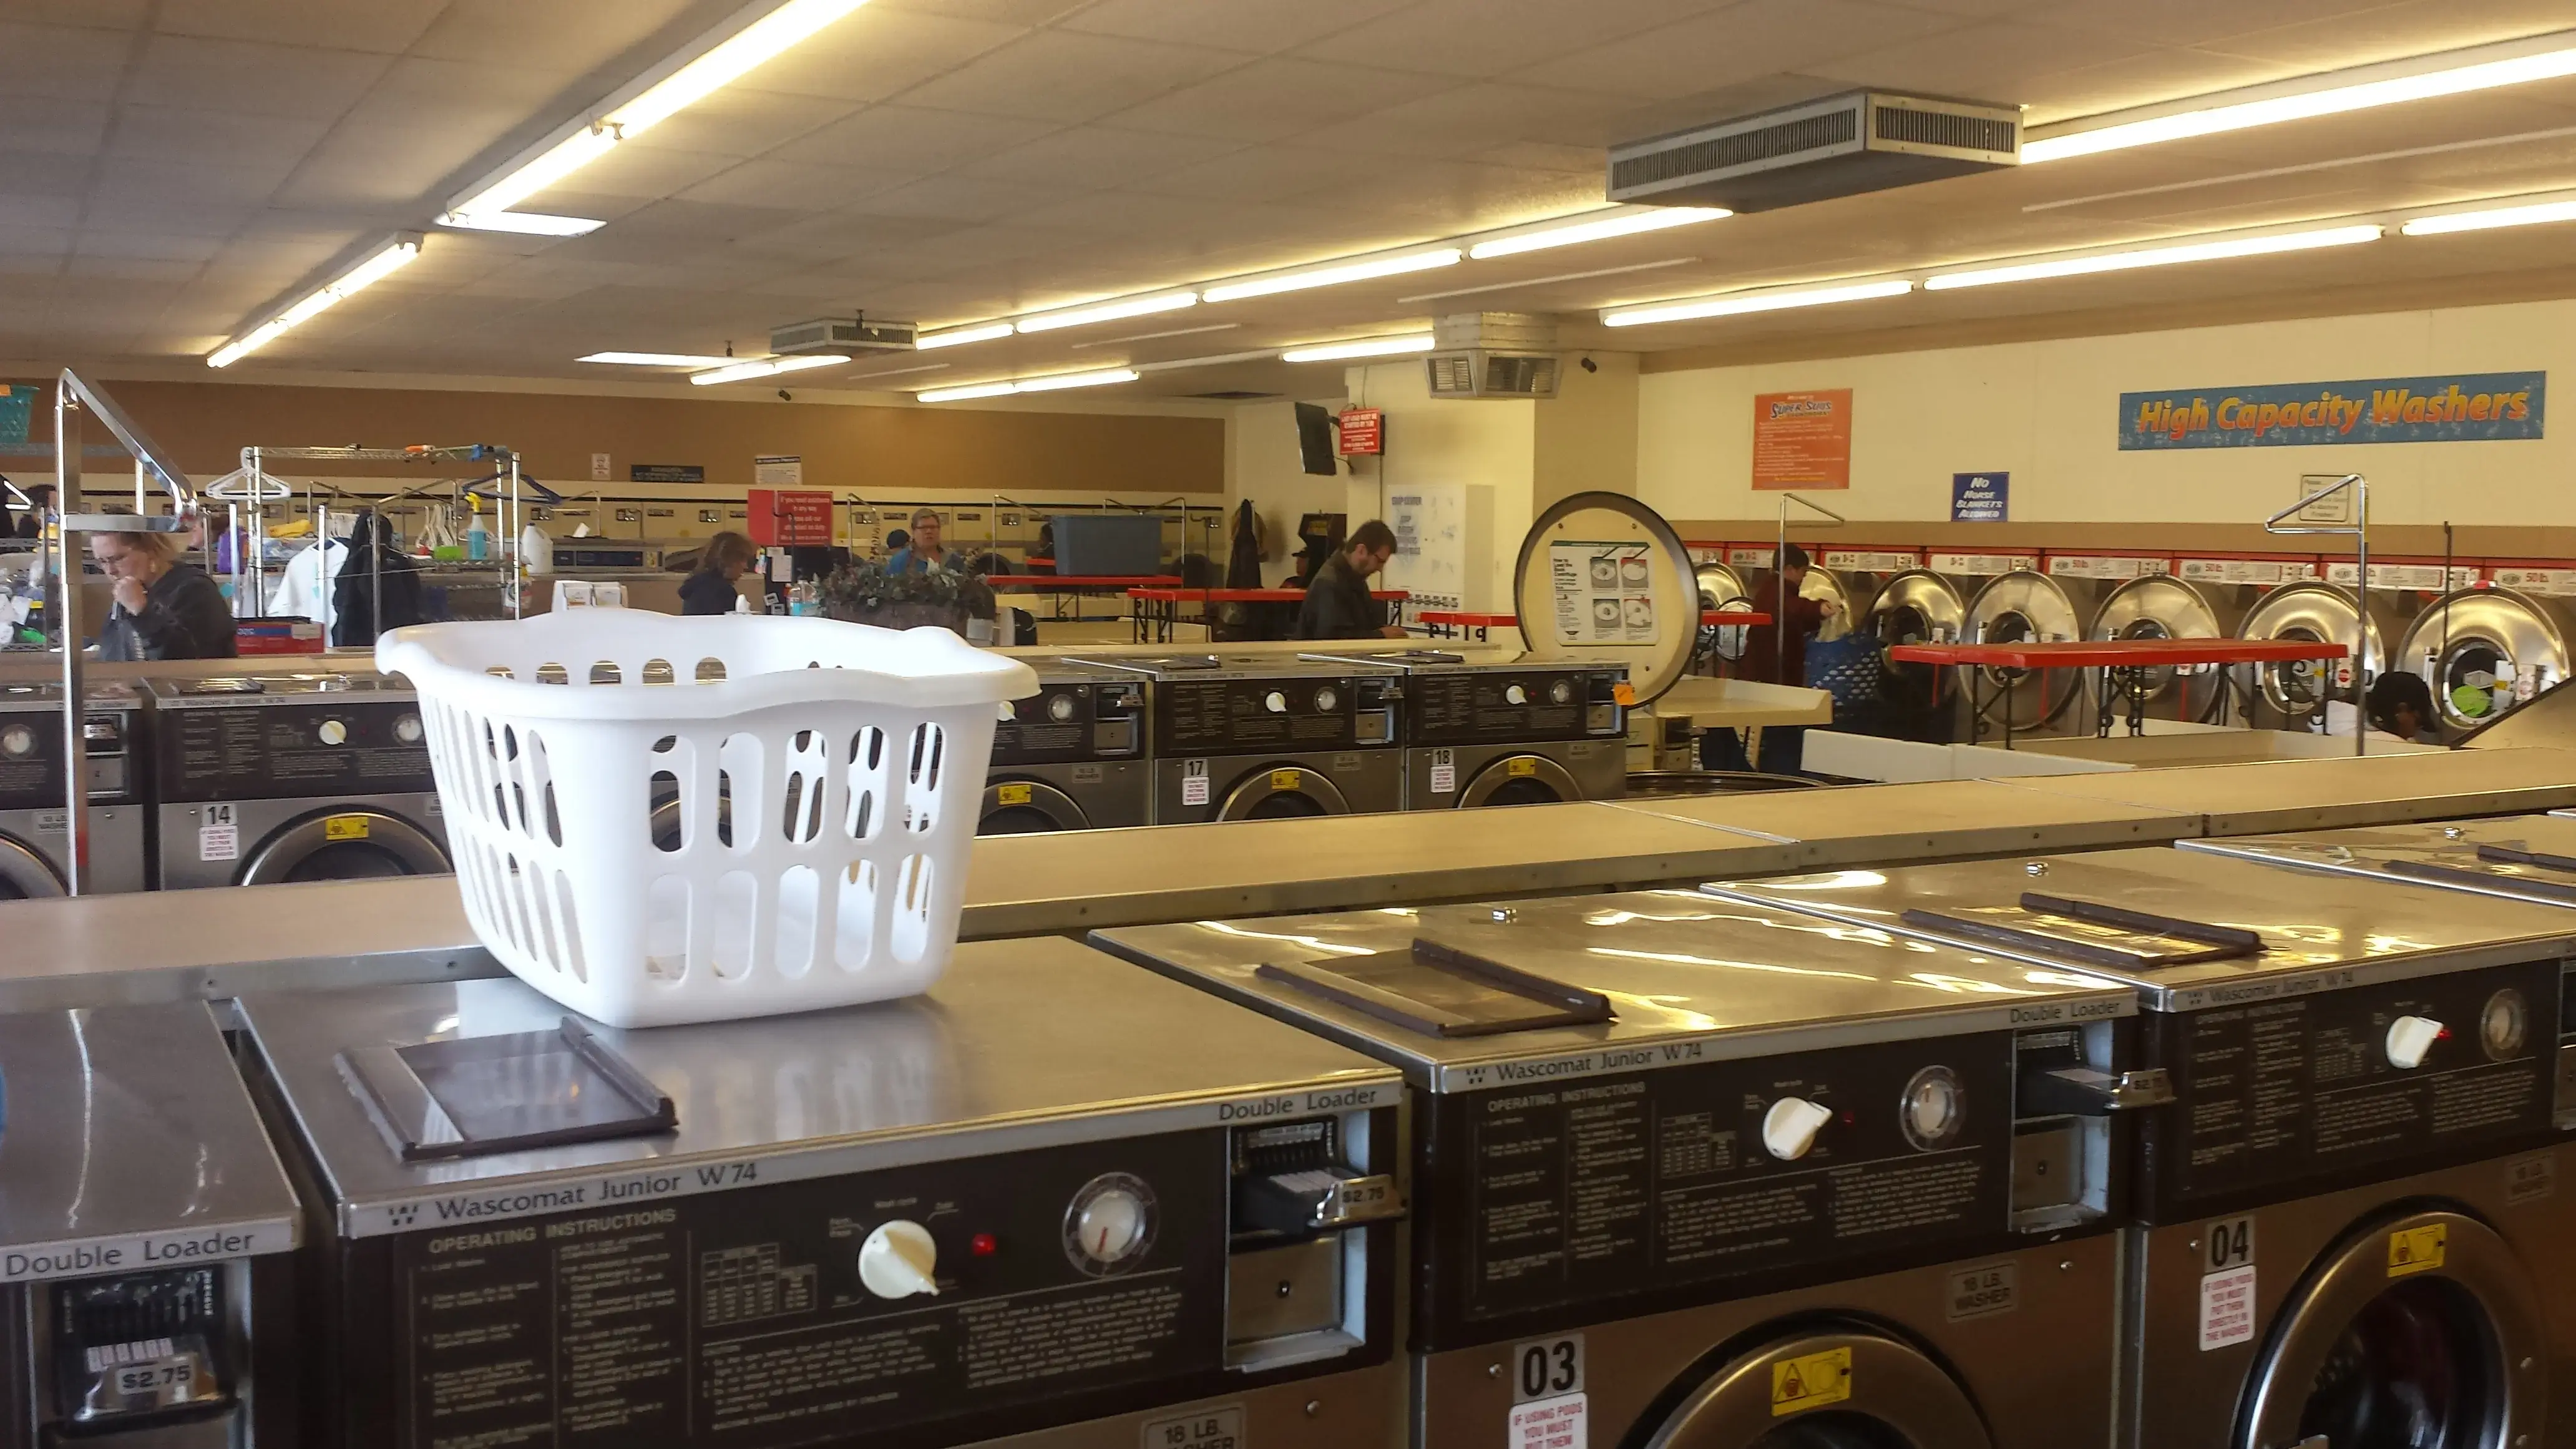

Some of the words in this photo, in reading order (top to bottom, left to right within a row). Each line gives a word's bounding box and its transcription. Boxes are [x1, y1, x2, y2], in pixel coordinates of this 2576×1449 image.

[2139, 397, 2209, 440] High
[2217, 391, 2364, 438] Capacity
[2372, 384, 2530, 424] Washers
[1188, 761, 1203, 776] 17
[1435, 749, 1450, 764] 18
[207, 805, 230, 824] 14
[2010, 1003, 2062, 1023] Double
[2071, 1000, 2120, 1017] Loader
[1496, 1056, 1592, 1081] Wascomat
[1599, 1049, 1654, 1070] Junior
[1219, 1096, 1294, 1121] Double
[1306, 1088, 1378, 1111] Loader
[1487, 1093, 1556, 1113] OPERATING
[1561, 1081, 1646, 1103] INSTRUCTIONS
[435, 1186, 585, 1221] Wascomat
[598, 1173, 681, 1202] Junior
[428, 1226, 537, 1254] OPERATING
[545, 1208, 677, 1239] INSTRUCTIONS
[2212, 1221, 2250, 1267] 04
[5, 1246, 122, 1277] Double
[144, 1232, 255, 1261] Loader
[122, 1365, 191, 1390] $2.75
[1523, 1340, 1576, 1397] 03
